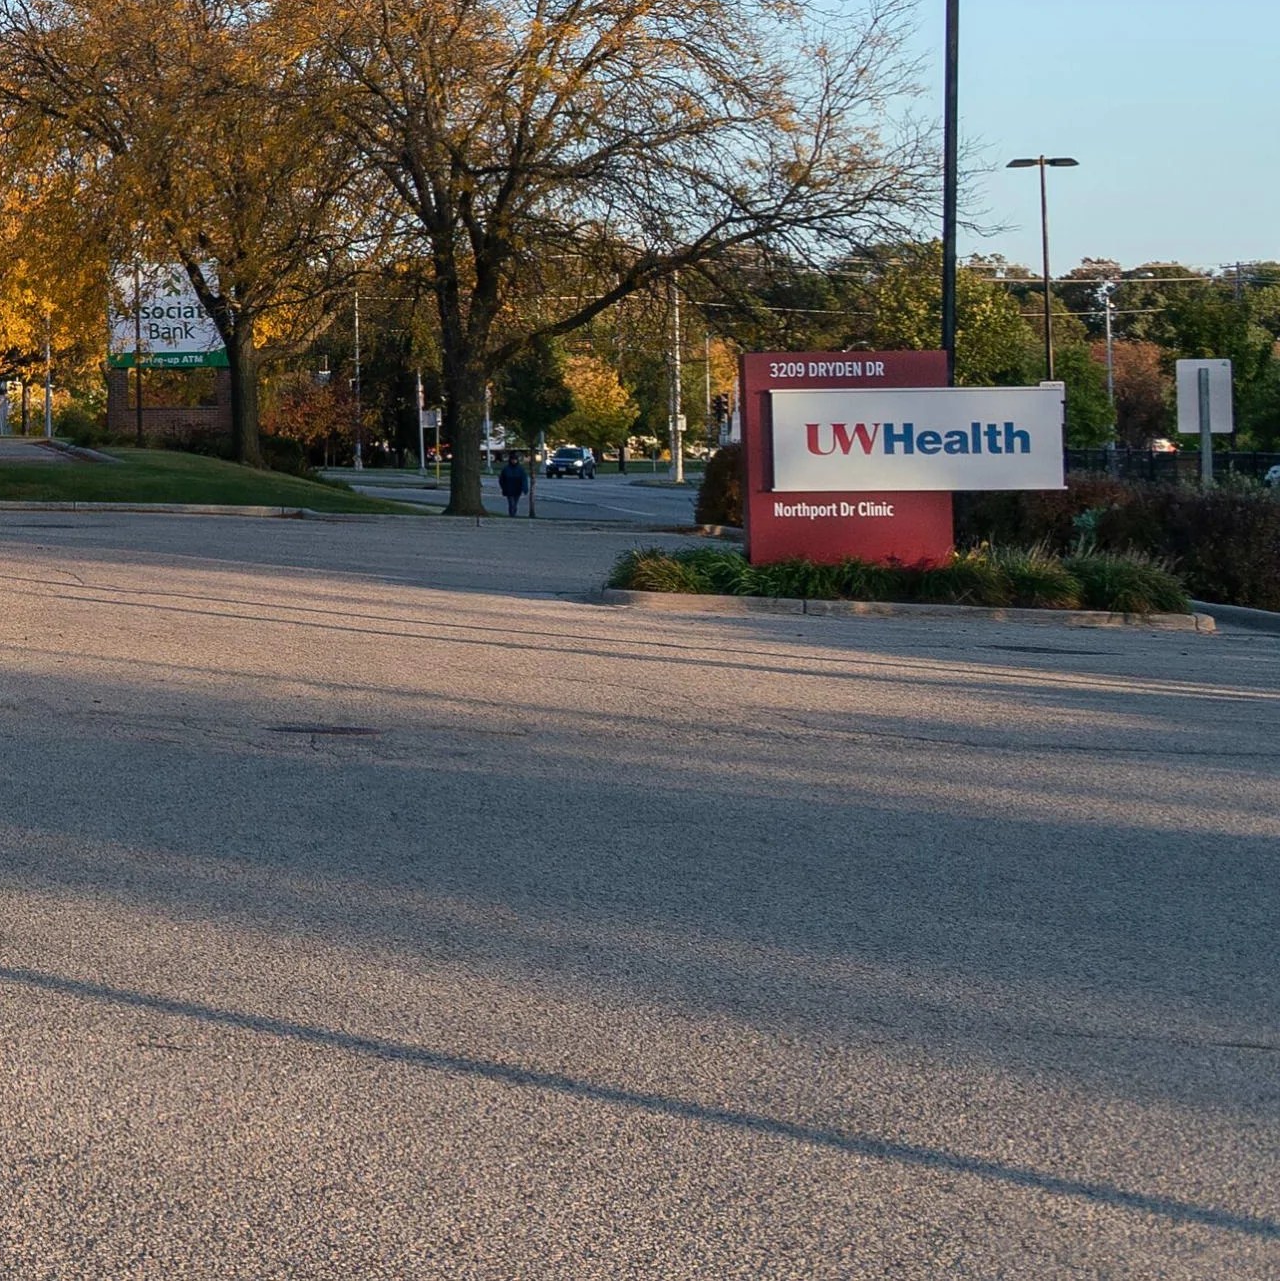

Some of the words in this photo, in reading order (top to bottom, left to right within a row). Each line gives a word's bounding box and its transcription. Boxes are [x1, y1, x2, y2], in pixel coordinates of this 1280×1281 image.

[148, 323, 195, 339] Bank
[181, 355, 204, 364] ATM
[769, 362, 806, 378] 3209
[808, 361, 863, 377] DRYDEN
[865, 361, 886, 376] DR
[773, 501, 839, 520] Northport
[840, 501, 856, 517] Dr
[858, 501, 895, 517] Clinic
